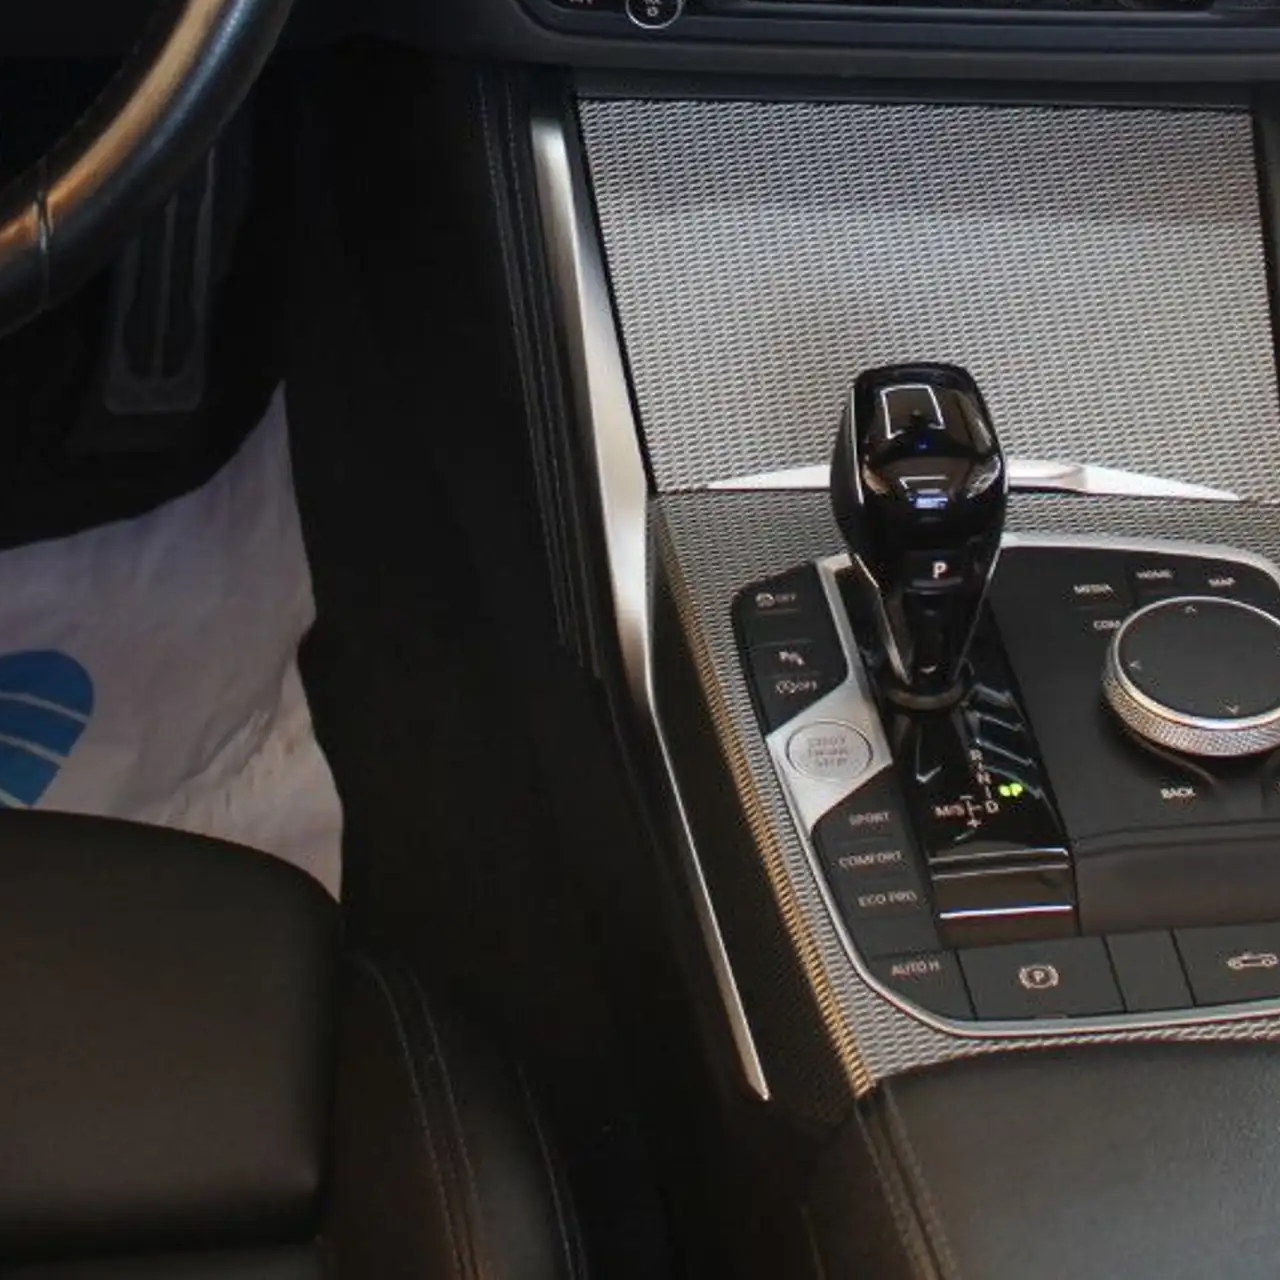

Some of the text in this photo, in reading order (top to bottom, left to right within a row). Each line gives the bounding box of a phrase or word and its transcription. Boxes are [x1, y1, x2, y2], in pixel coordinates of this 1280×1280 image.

[932, 561, 948, 579] P
[1160, 787, 1196, 800] BACK
[985, 800, 999, 814] D
[849, 811, 890, 826] SPORT
[838, 850, 902, 870] COMFORT
[857, 893, 886, 908] ECO
[891, 960, 927, 977] AUTO
